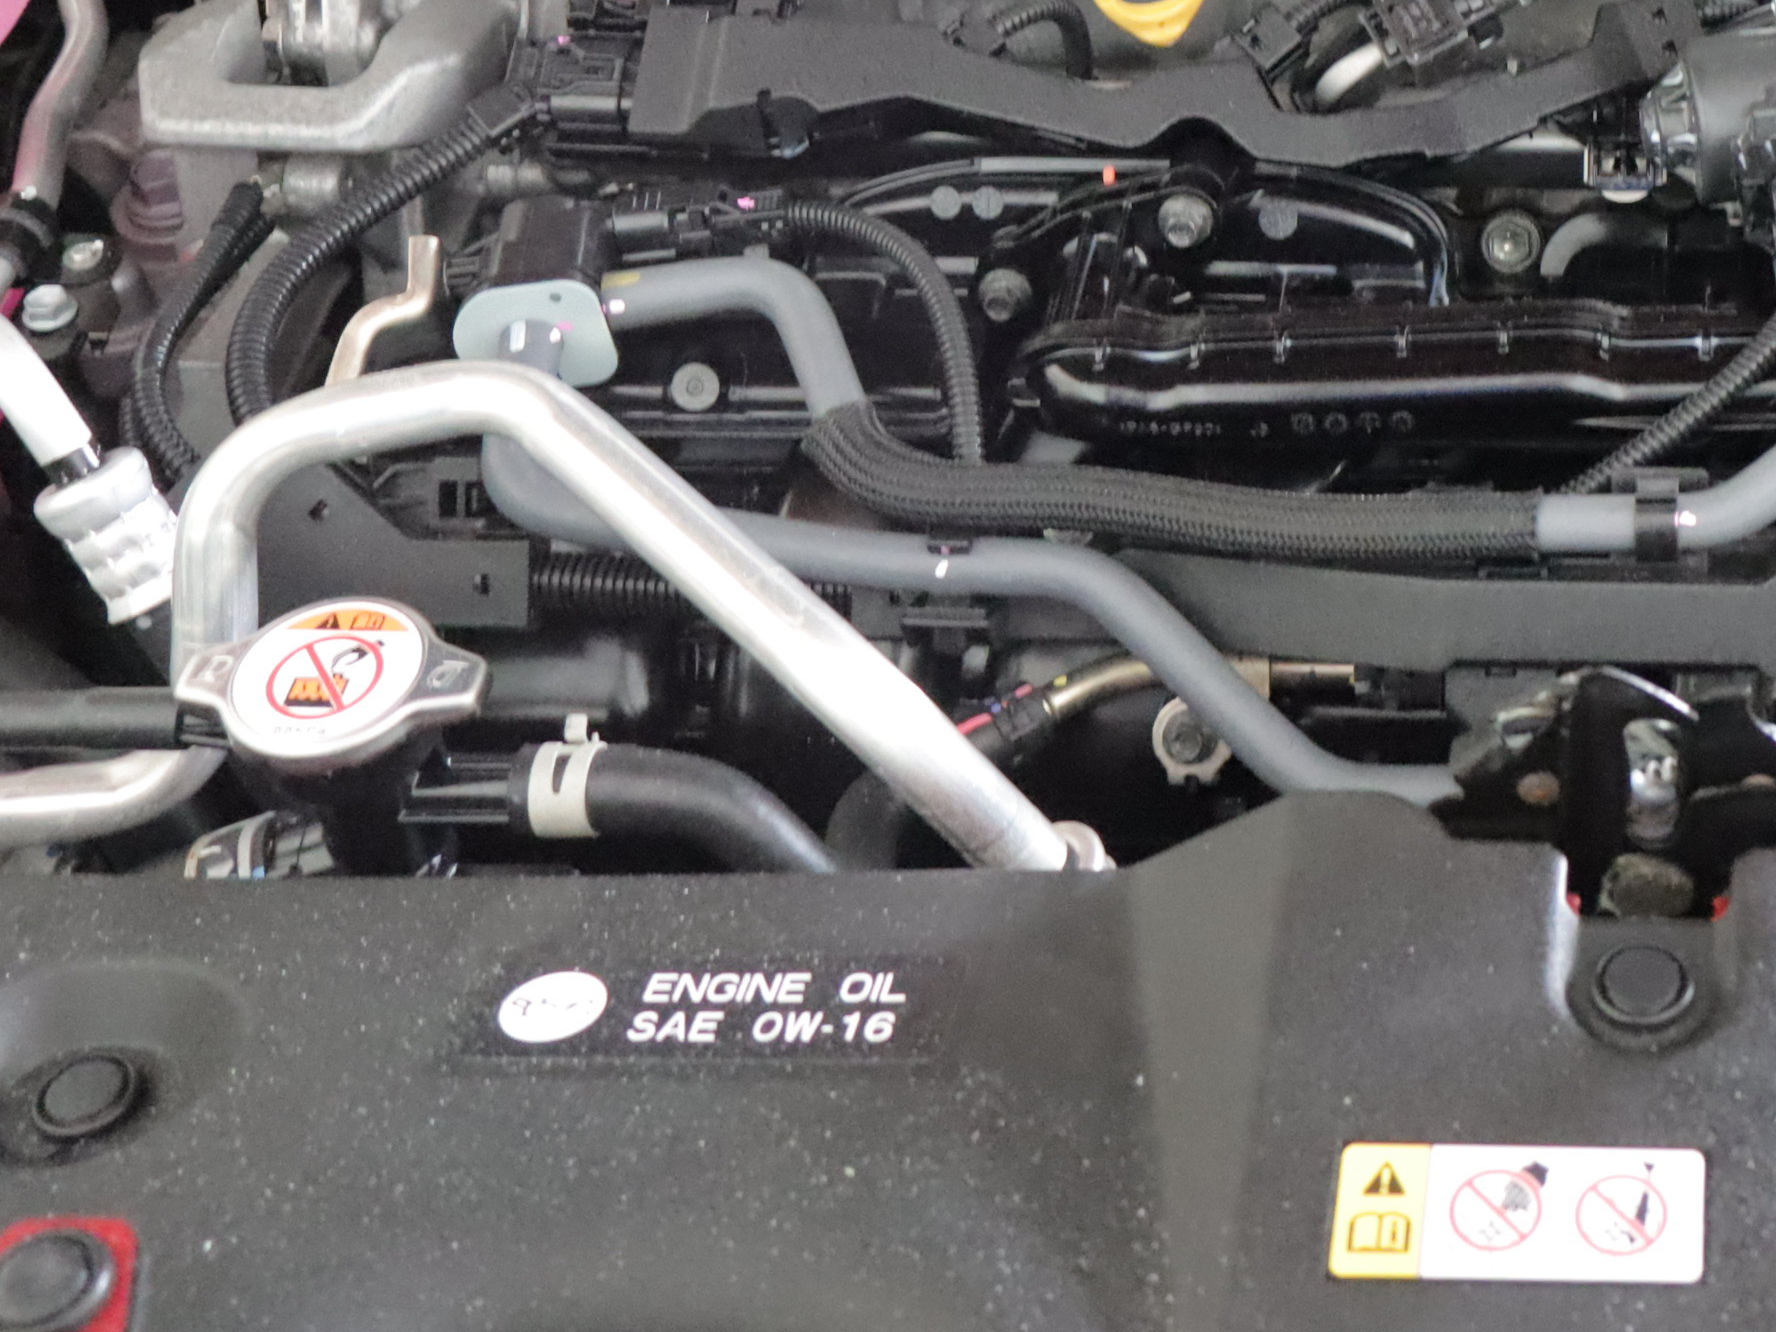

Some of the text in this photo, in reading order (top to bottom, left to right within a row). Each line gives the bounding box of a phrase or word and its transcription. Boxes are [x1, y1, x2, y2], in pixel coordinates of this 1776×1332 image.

[642, 971, 907, 1004] ENGINE OIL
[627, 1011, 896, 1044] SAE 0W-16
